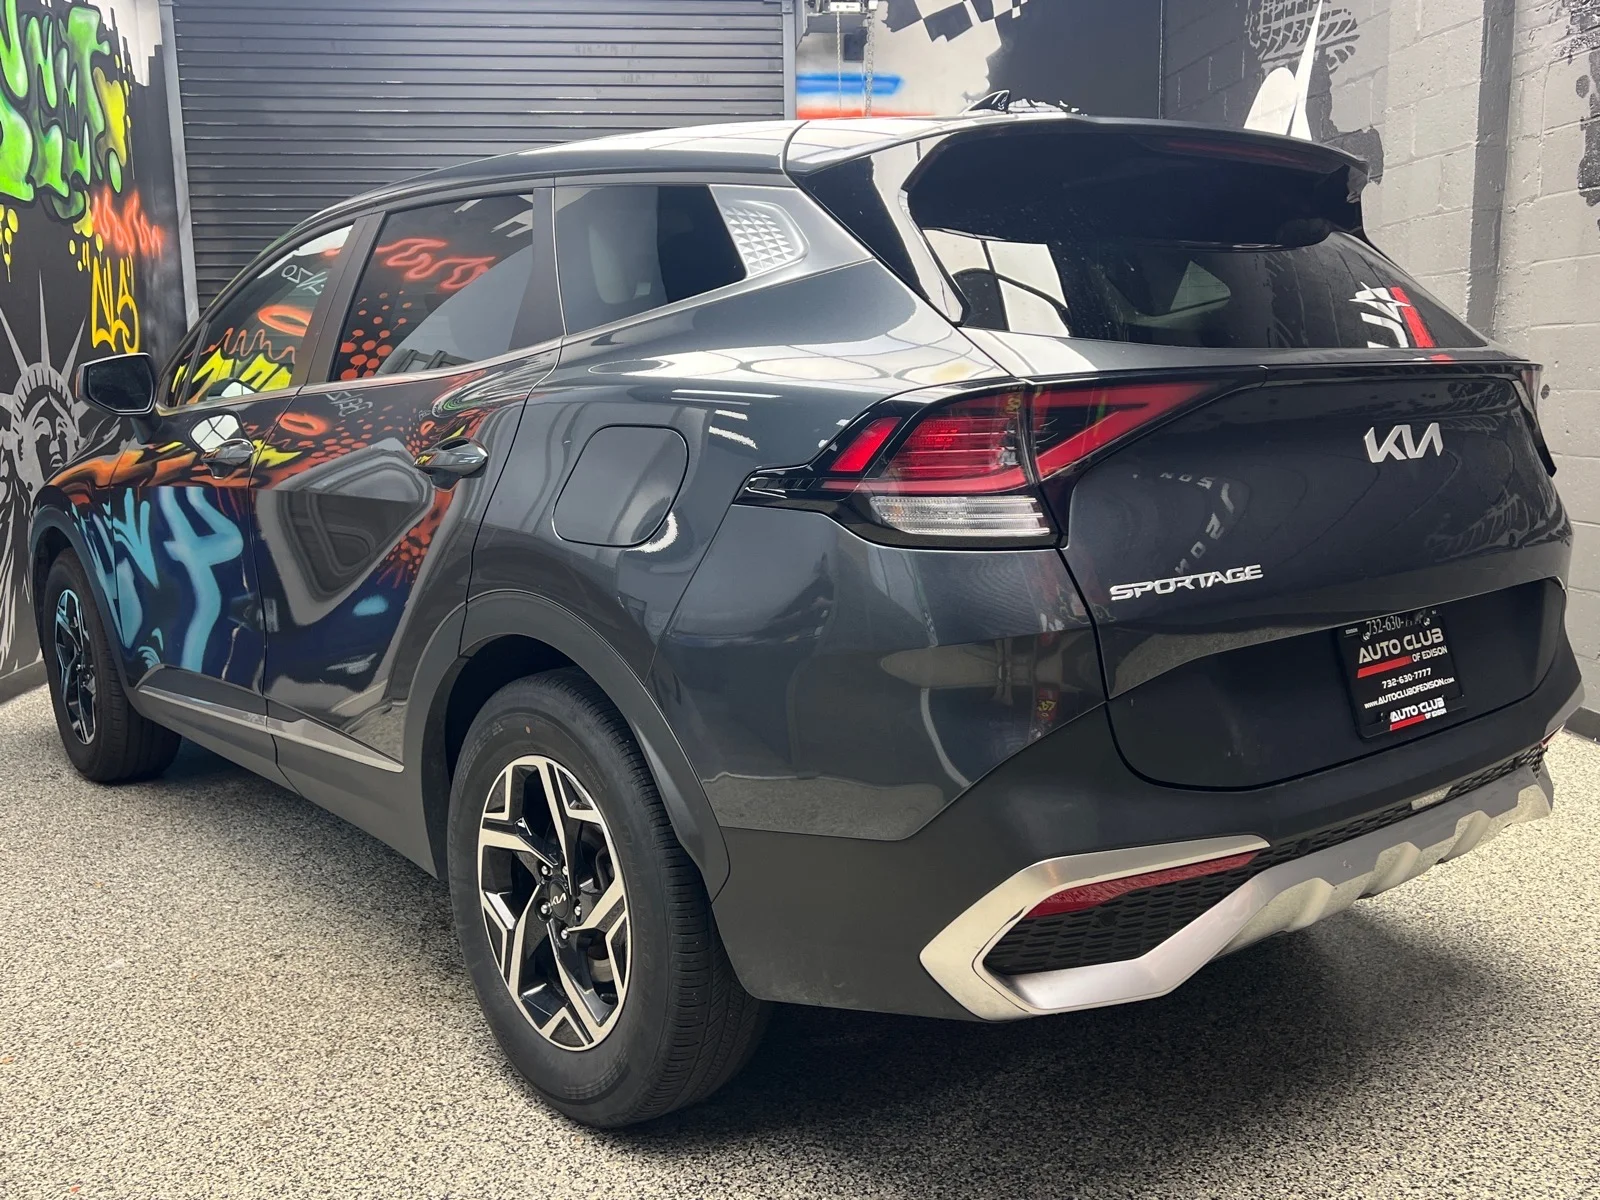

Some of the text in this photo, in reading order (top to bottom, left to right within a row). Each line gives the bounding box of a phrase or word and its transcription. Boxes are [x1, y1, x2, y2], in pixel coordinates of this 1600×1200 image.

[1364, 422, 1443, 463] KIA
[1110, 564, 1263, 600] SPORTAGE
[1359, 628, 1444, 664] AUTO CLUB
[1412, 646, 1448, 662] OF EDISON
[1382, 668, 1431, 689] 732-630-7777
[1390, 697, 1445, 723] AUTO CLUB
